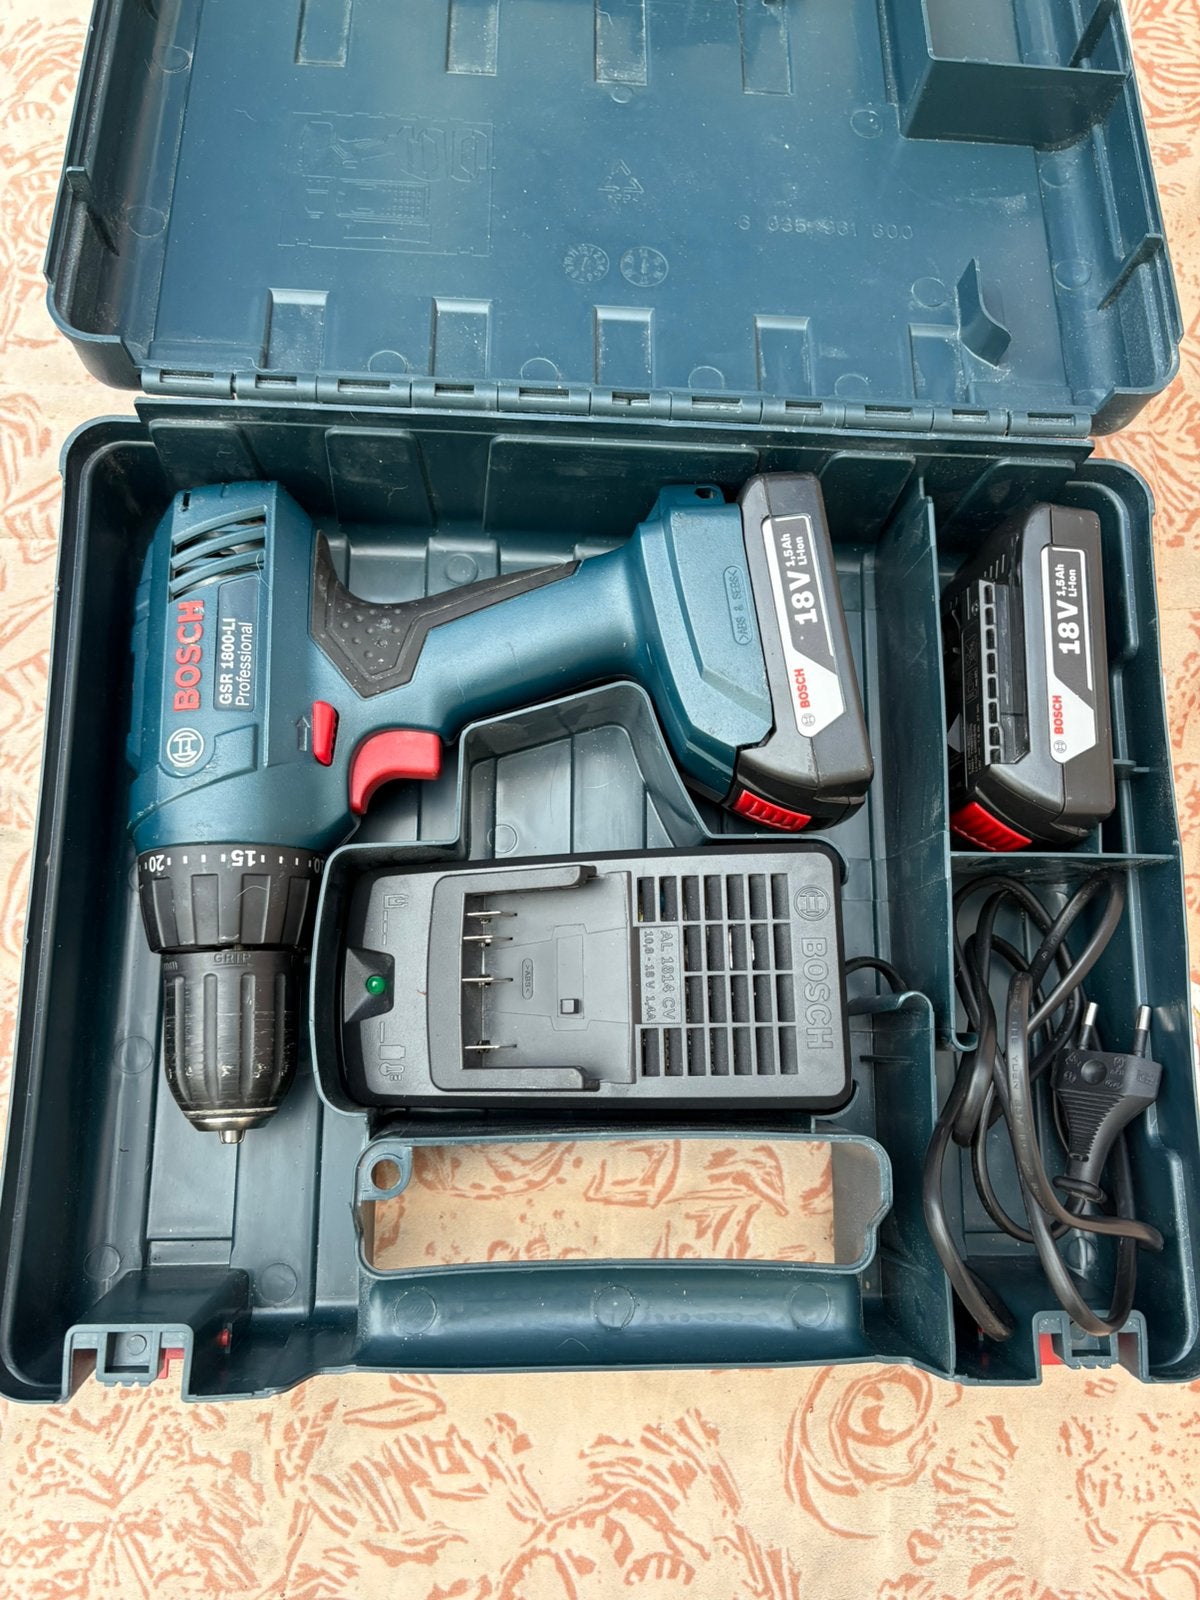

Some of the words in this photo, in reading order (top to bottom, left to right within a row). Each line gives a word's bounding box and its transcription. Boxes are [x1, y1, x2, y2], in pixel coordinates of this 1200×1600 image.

[781, 533, 796, 567] 1,5Ah
[796, 536, 808, 566] Li-Ion
[1054, 563, 1066, 596] 1,5Ah
[1067, 568, 1078, 598] Li-Ion
[786, 571, 819, 625] 18V
[221, 618, 236, 670] 1800-LI
[1055, 600, 1081, 655] 18V
[173, 599, 205, 712] BOSCH
[235, 622, 253, 706] Professional
[218, 674, 233, 705] GSR
[794, 668, 811, 709] BOSCH
[1052, 695, 1064, 735] BOSCH
[149, 854, 165, 873] 20
[231, 849, 257, 867] 15
[660, 930, 674, 952] AL
[213, 952, 251, 964] GRIP
[645, 980, 656, 989] V
[800, 937, 834, 1050] BOSCH
[662, 996, 676, 1020] CV
